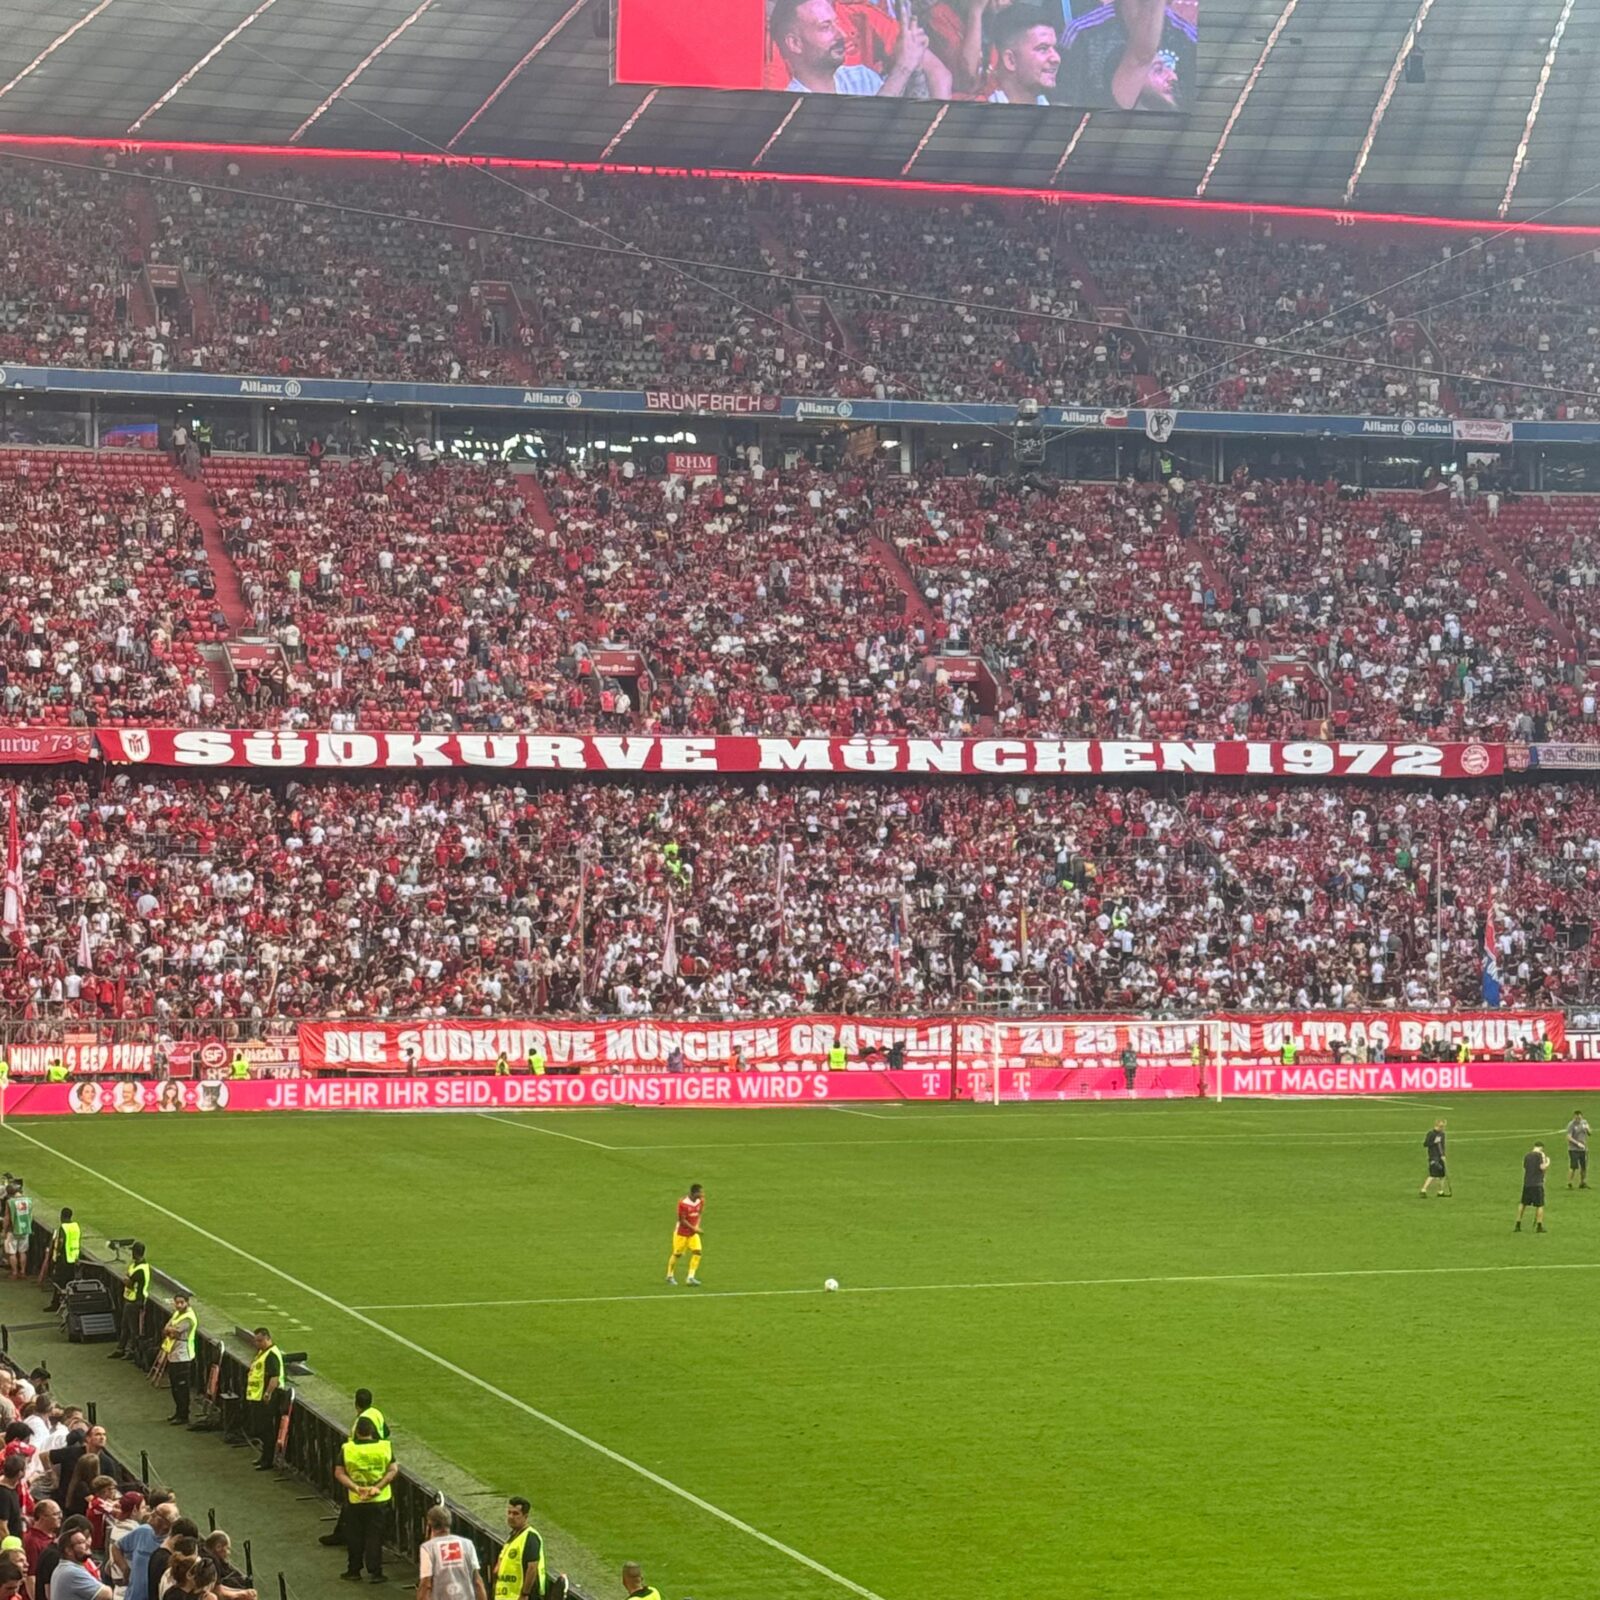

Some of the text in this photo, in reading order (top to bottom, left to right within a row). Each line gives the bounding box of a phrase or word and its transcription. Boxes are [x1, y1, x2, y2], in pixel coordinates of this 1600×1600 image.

[240, 380, 282, 394] Allianz
[524, 391, 565, 406] Allianz
[797, 401, 836, 414] Allianz
[1061, 411, 1099, 423] Allianz
[1362, 420, 1399, 433] Allianz
[1417, 422, 1452, 434] Global
[675, 455, 713, 468] RHM
[173, 730, 719, 771] SÜDKURVE
[758, 738, 1216, 774] MÜNCHEN
[1246, 742, 1444, 777] 1972
[324, 1029, 386, 1064] DIE
[397, 1023, 597, 1063] SÜDKURVE
[605, 1023, 779, 1061] MÜNCHEN
[1020, 1025, 1063, 1055] ZU
[1075, 1024, 1117, 1054] 25
[1262, 1018, 1389, 1052] ULTRAS
[80, 1044, 109, 1072] RED
[112, 1042, 153, 1072] PRIDE
[204, 1048, 223, 1062] SF
[1233, 1065, 1473, 1091] MIT MAGENTA MOBIL
[266, 1083, 298, 1107] JE
[304, 1082, 379, 1107] MEHR
[385, 1081, 428, 1106] IHR
[434, 1080, 499, 1106] SEID,
[504, 1078, 586, 1105] DESTO
[591, 1074, 732, 1102] GÜNSTIGER
